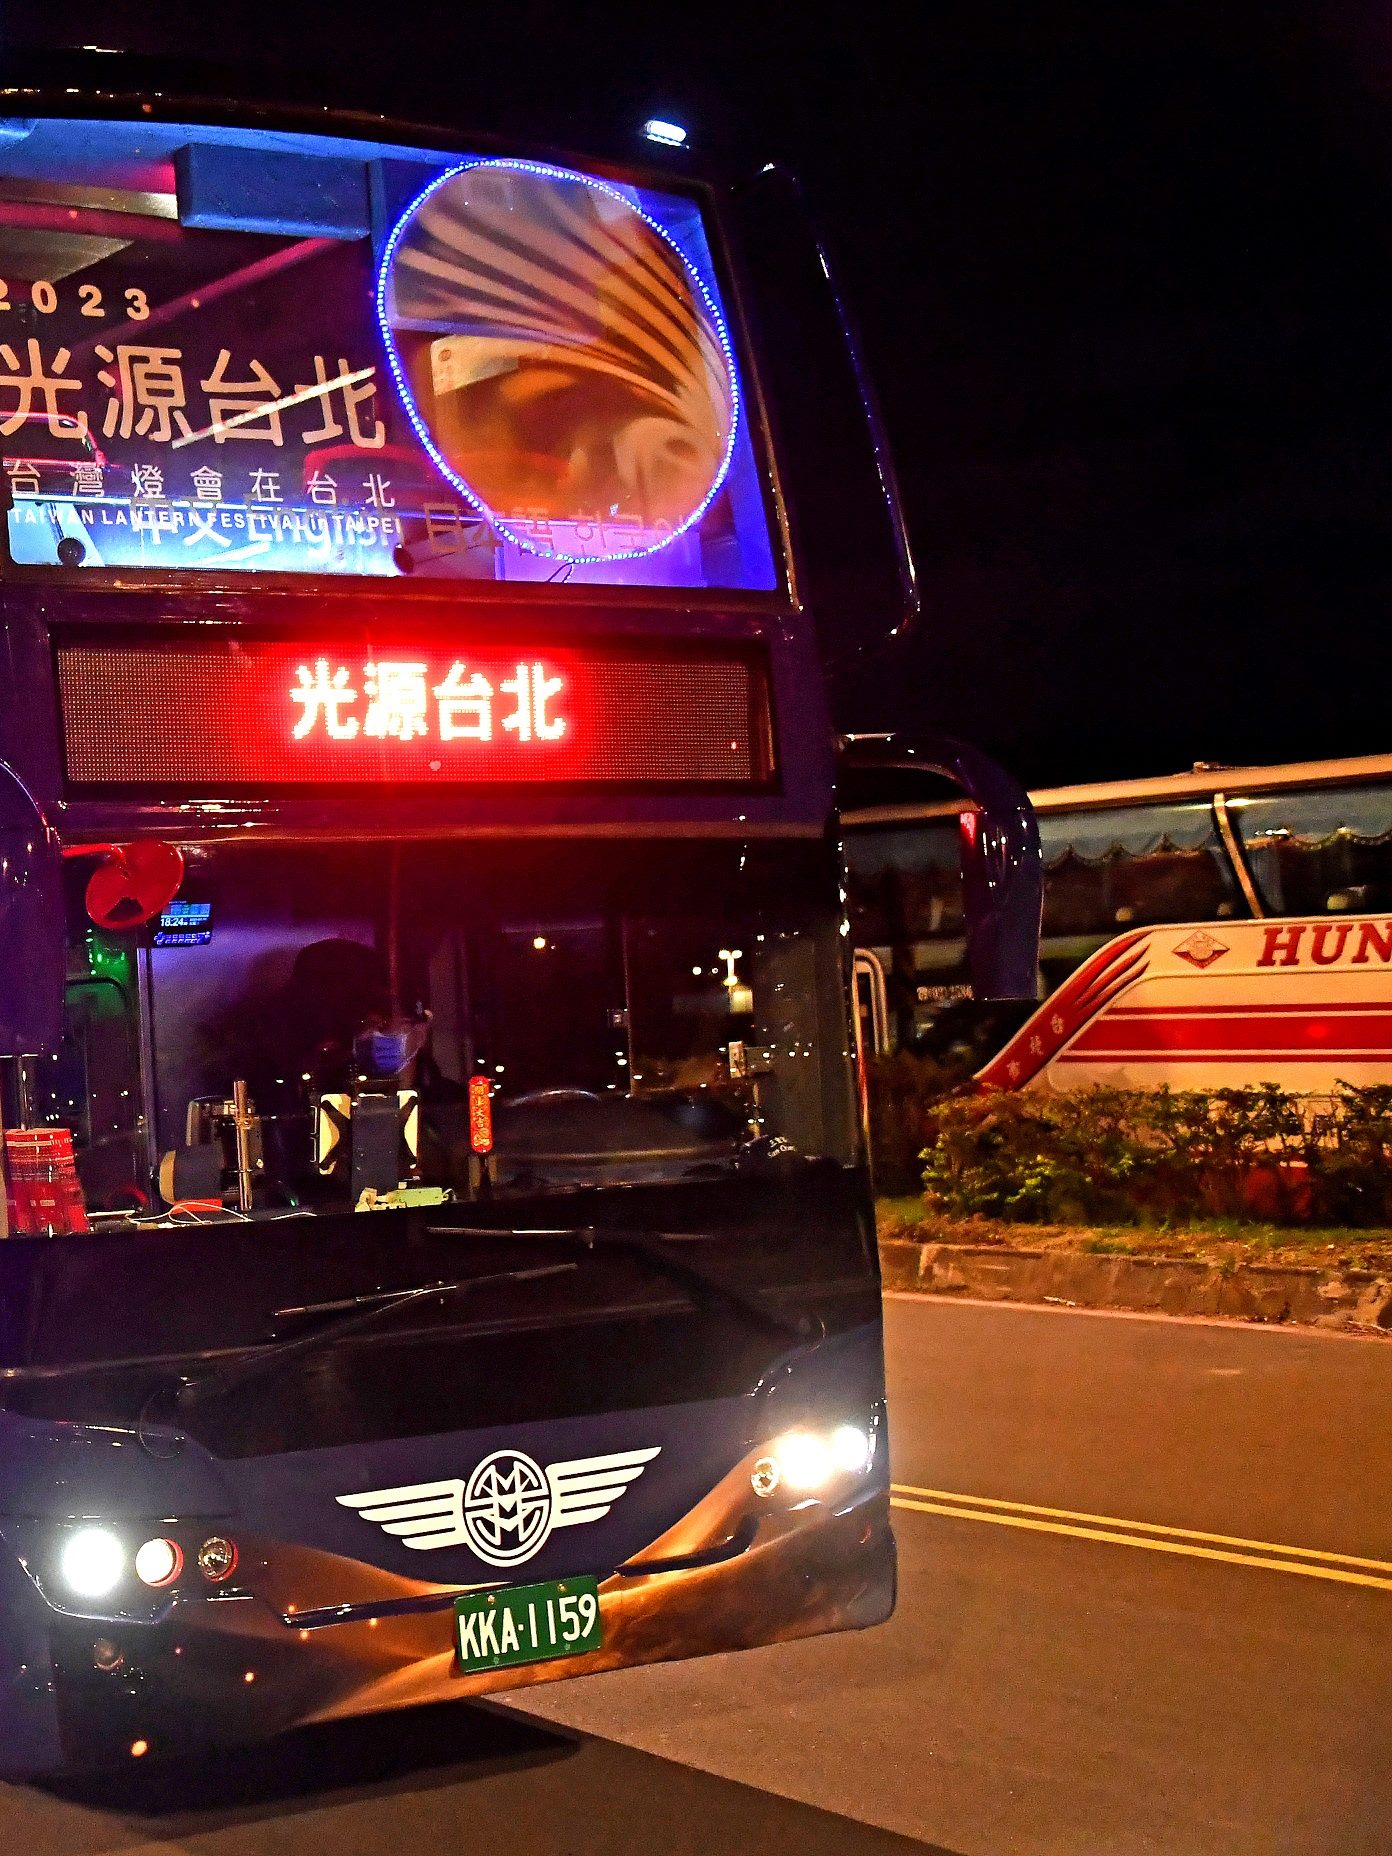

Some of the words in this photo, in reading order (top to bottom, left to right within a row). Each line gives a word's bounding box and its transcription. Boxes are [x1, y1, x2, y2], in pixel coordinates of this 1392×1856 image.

[7, 460, 396, 509] 台灣燈會在台北
[289, 657, 567, 741] 光源台北
